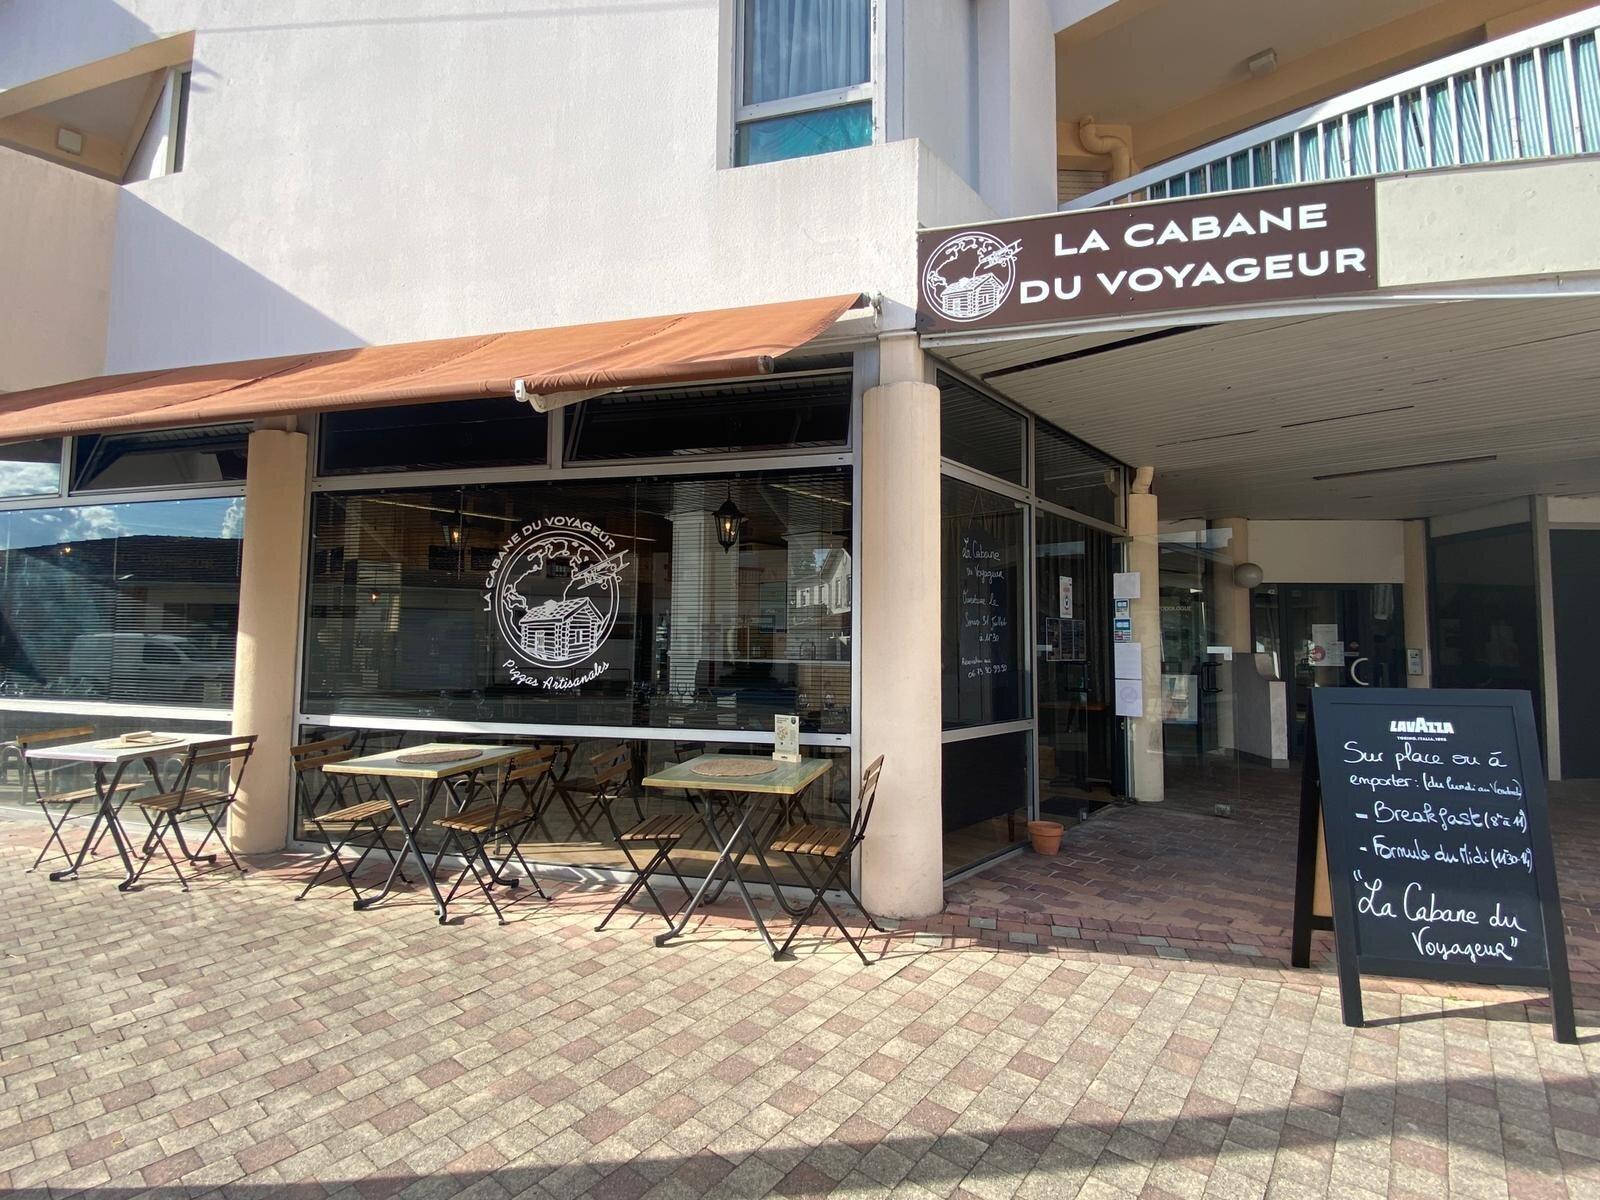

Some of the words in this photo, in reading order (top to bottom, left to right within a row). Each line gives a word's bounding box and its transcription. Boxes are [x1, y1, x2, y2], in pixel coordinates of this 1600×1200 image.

[1055, 230, 1109, 257] LA
[1124, 203, 1327, 247] CABANE
[1019, 276, 1082, 304] DU
[1097, 247, 1365, 295] VOYAGEUR
[522, 520, 542, 536] DU
[545, 516, 616, 550] VOYAGEUR
[486, 533, 521, 588] CABANE
[483, 592, 492, 612] LA
[502, 659, 538, 686] Pizzas
[543, 661, 609, 689] Artisanales
[1390, 717, 1455, 734] LAVAZZA
[1344, 740, 1383, 763] Sur
[1395, 742, 1444, 770] place
[1452, 754, 1480, 766] ou
[1374, 800, 1484, 831] Breakfast
[1373, 835, 1431, 860] Formule
[1434, 844, 1458, 864] du
[1459, 844, 1489, 864] Midi
[1404, 882, 1479, 924] Cabane
[1489, 903, 1527, 932] du
